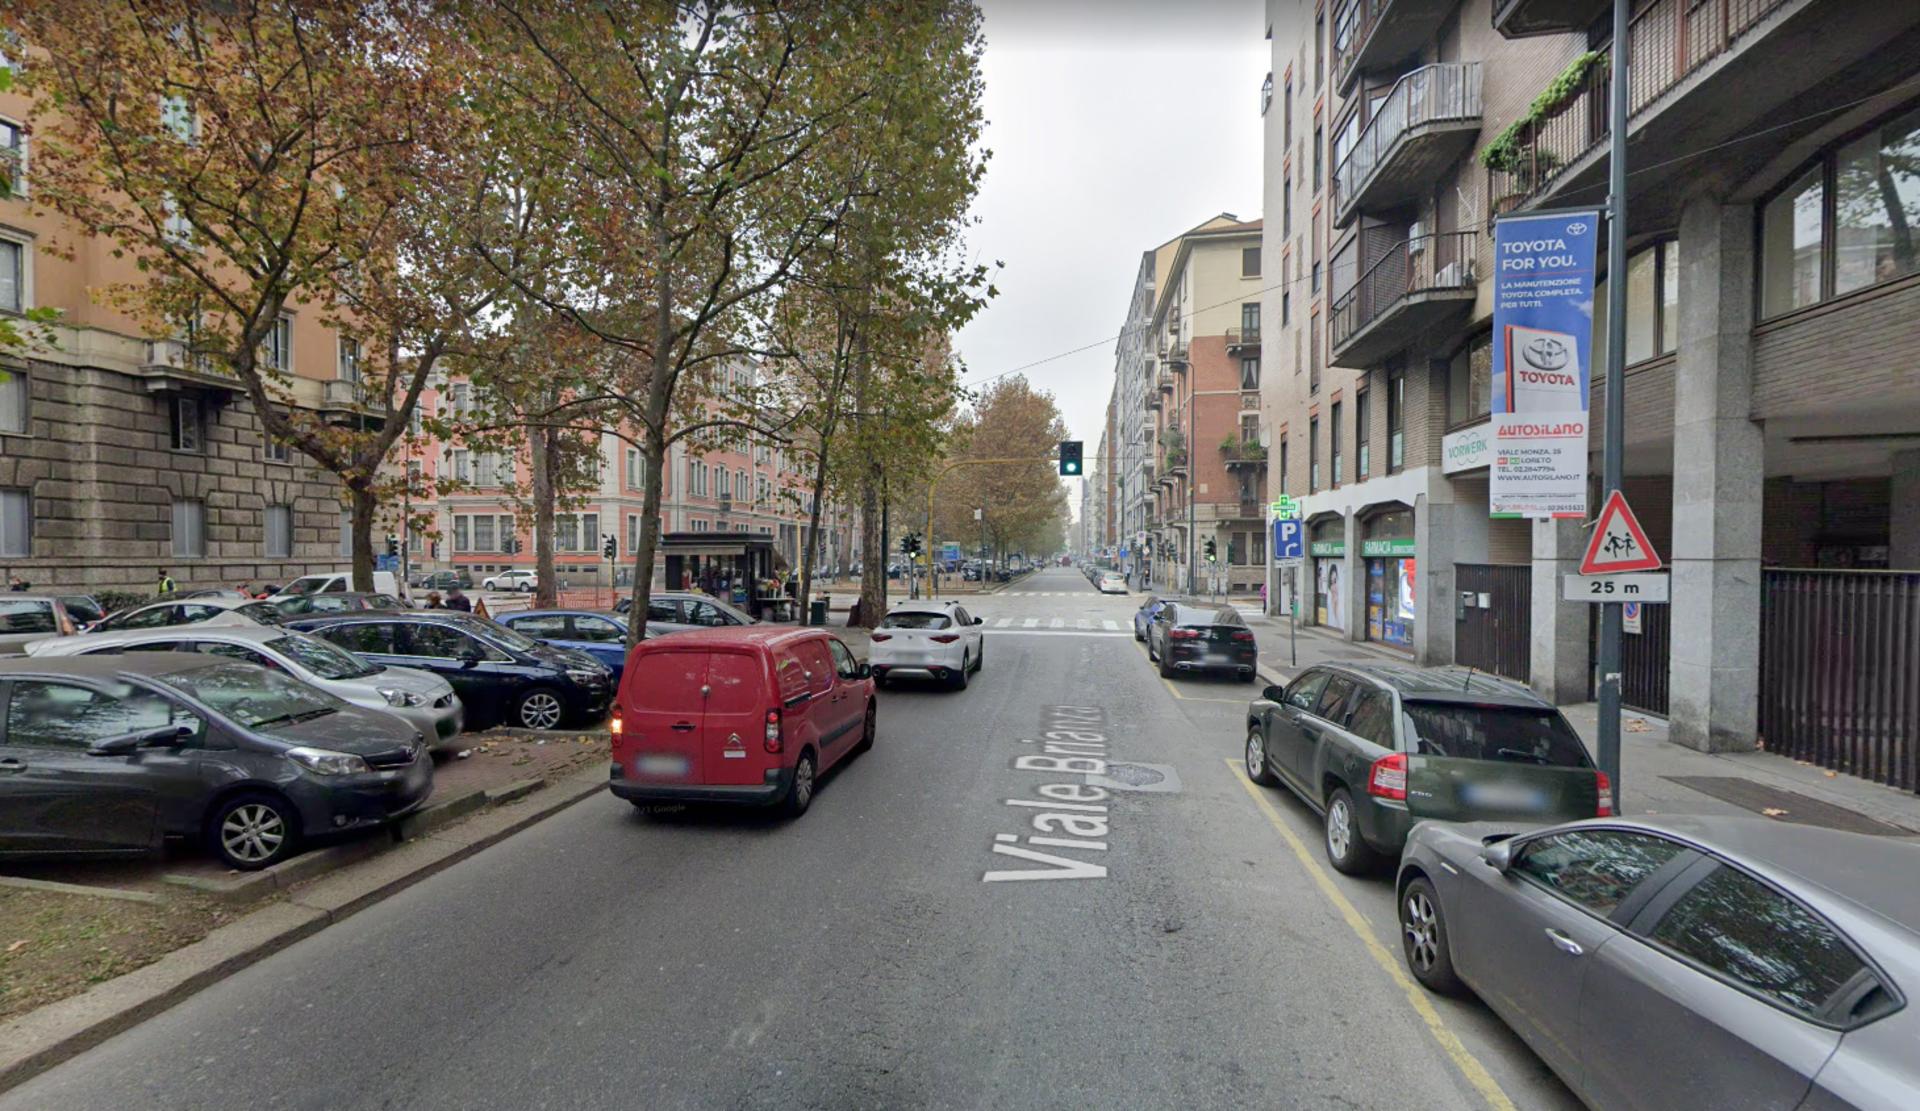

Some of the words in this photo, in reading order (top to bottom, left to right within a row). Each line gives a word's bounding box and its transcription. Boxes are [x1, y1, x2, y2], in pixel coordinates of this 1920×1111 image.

[1502, 239, 1566, 254] TOYOTA
[1502, 257, 1535, 271] FOR
[1538, 255, 1577, 268] YOU.
[1501, 281, 1512, 289] LA
[1513, 278, 1581, 289] MANUTENZIONE
[1501, 290, 1534, 299] TOYOTA
[1535, 288, 1583, 298] COMPLETA.
[1501, 301, 1518, 309] PER
[1519, 371, 1575, 385] TOYOTA
[1448, 439, 1488, 459] VORWERK
[1281, 522, 1297, 541] P
[1590, 581, 1615, 594] 25
[1624, 583, 1639, 594] m
